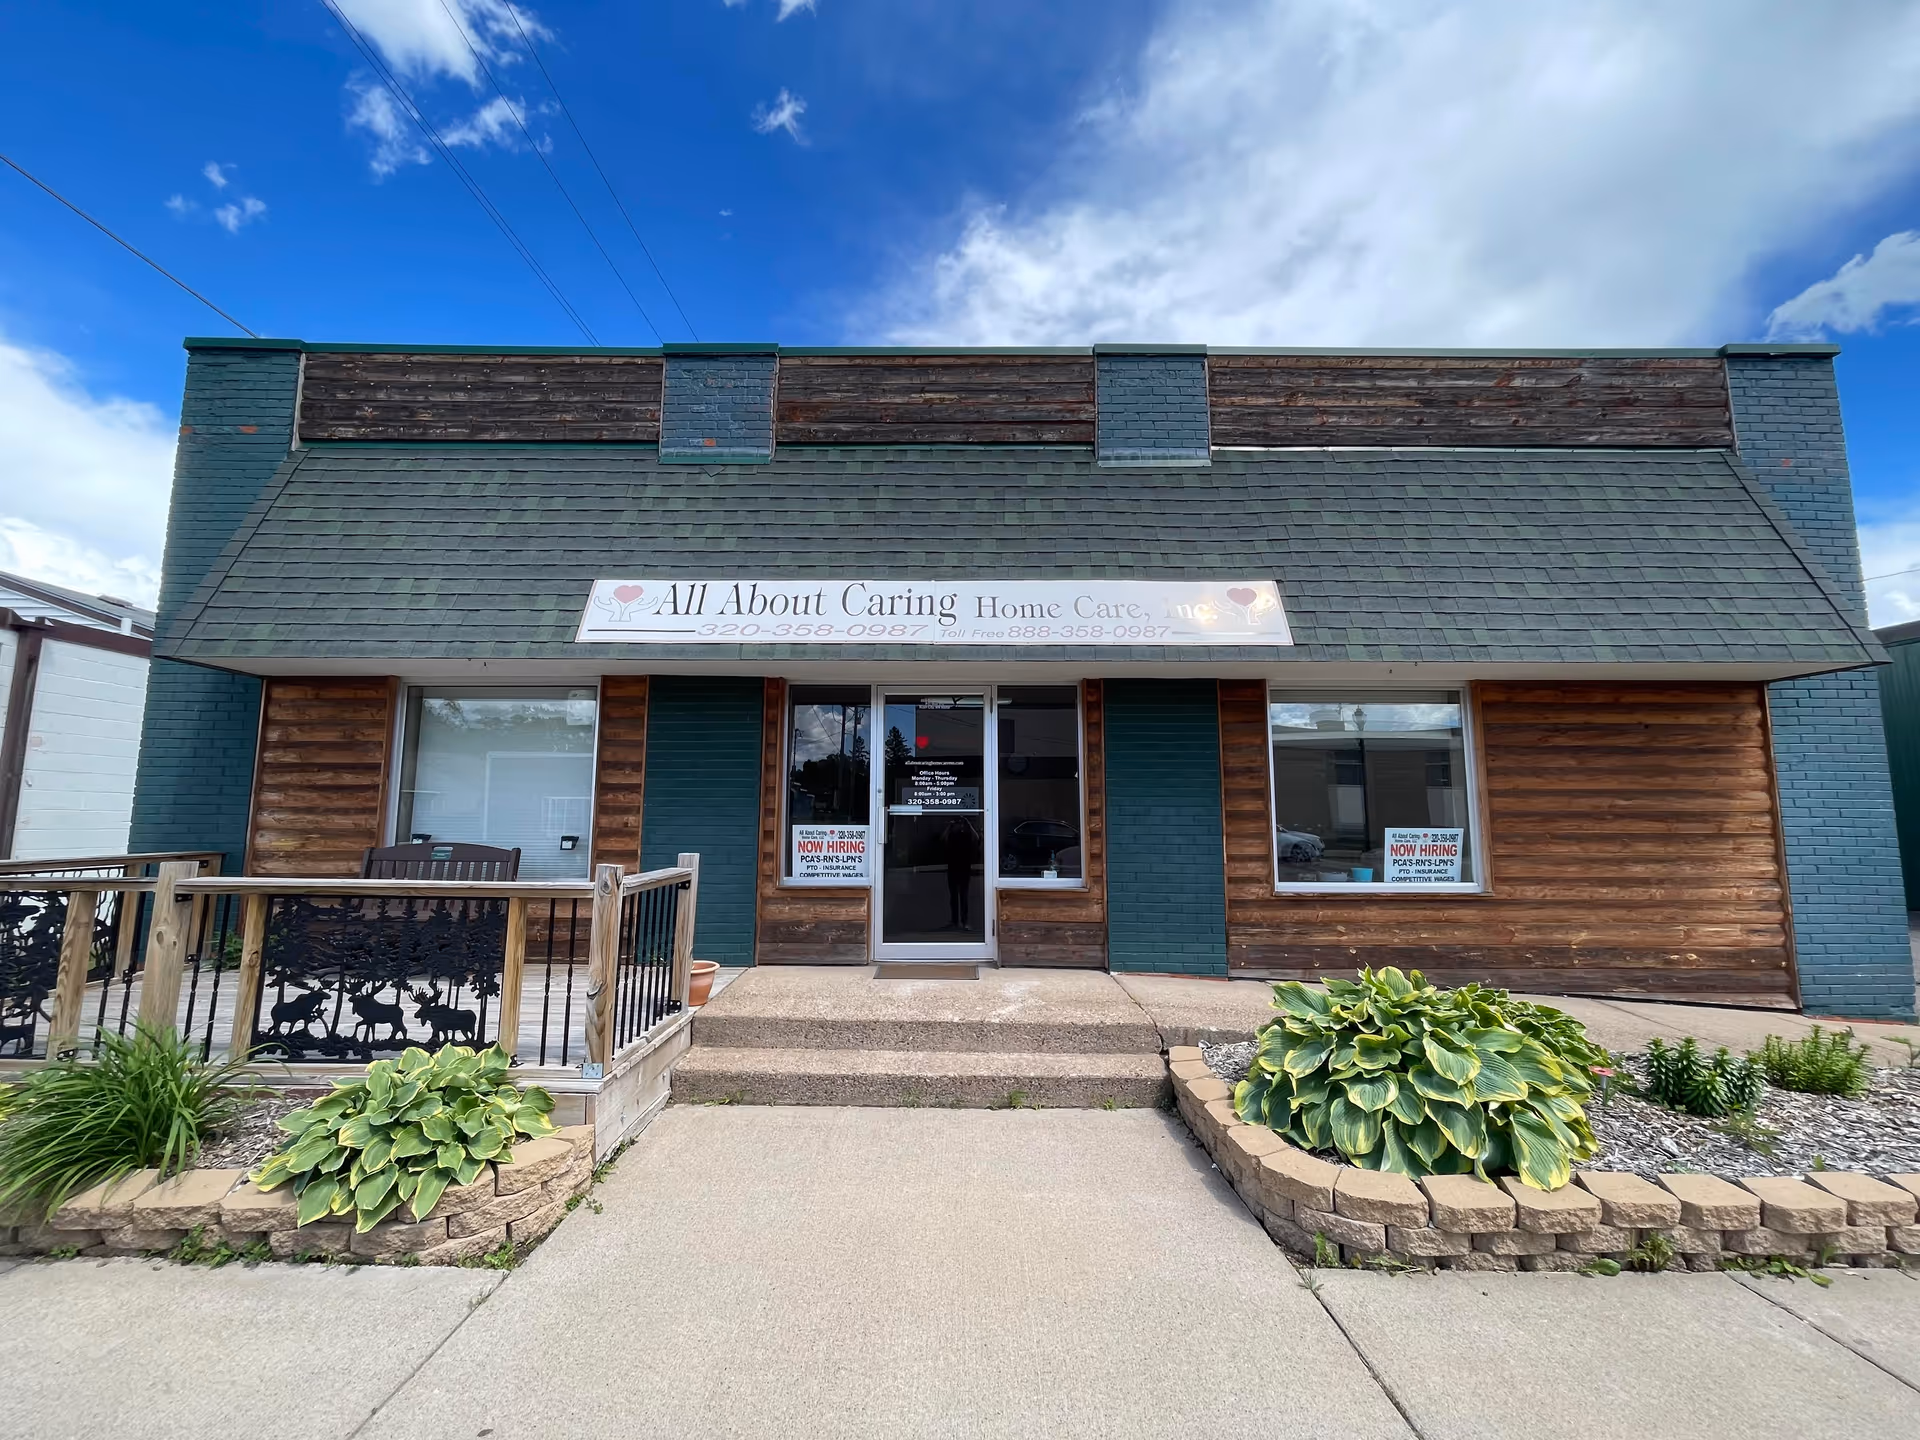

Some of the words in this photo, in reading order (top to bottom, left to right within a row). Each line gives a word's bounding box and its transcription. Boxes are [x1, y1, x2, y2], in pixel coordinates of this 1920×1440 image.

[652, 582, 709, 616] All
[716, 582, 827, 617] About
[841, 582, 959, 626] Caring
[974, 595, 1063, 619] Home
[1073, 595, 1152, 622] Care,
[696, 623, 929, 638] 320-358-0987
[940, 628, 966, 638] Toll
[972, 628, 1005, 638] Free
[1007, 625, 1171, 639] 888-358-0987
[798, 841, 823, 853] NOW
[827, 841, 865, 853] HIRING
[1390, 844, 1416, 856] NOW
[1420, 844, 1457, 856] HIRING
